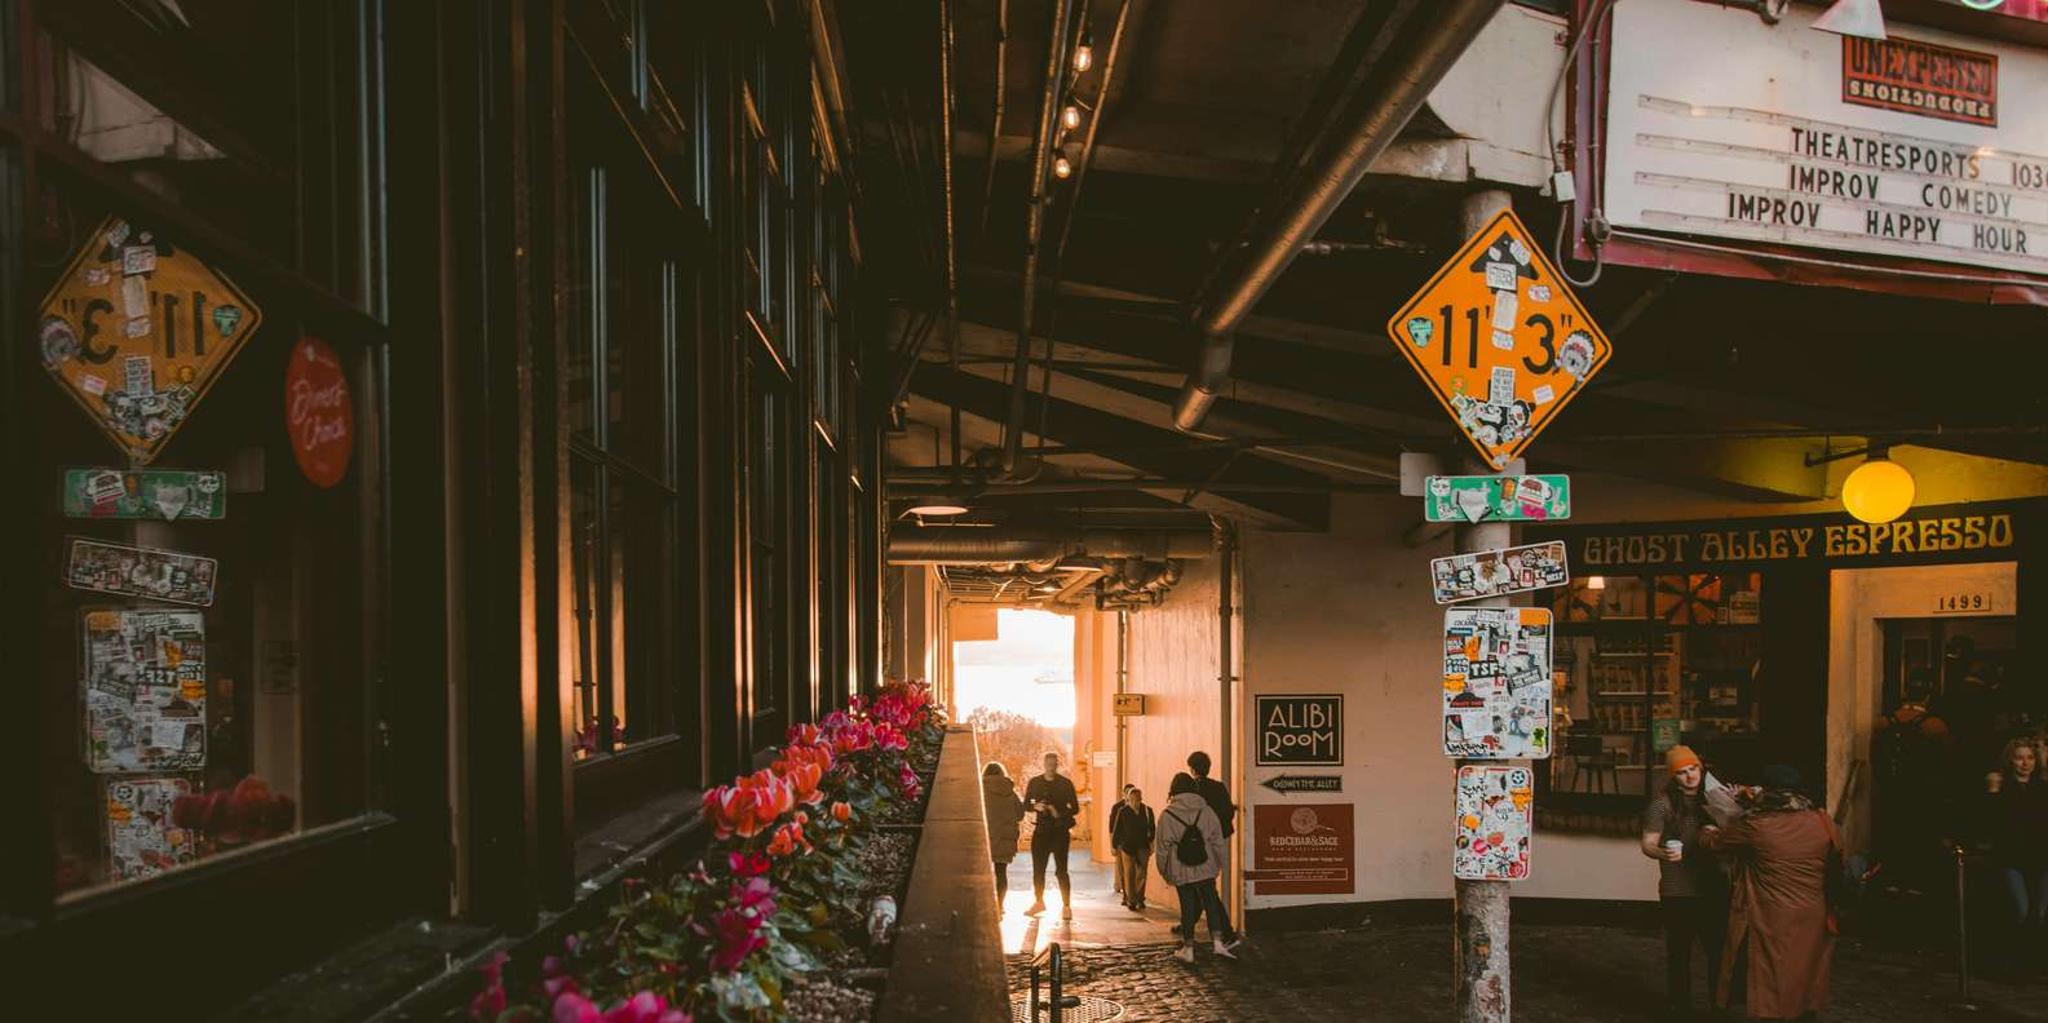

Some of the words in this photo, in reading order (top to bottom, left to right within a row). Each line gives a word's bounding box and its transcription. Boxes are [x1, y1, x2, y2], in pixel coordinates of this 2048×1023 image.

[1850, 80, 1990, 117] PRODUCTIONS
[1791, 127, 1980, 180] THEATRESPORTS
[2012, 162, 2048, 189] 103
[1790, 164, 1879, 200] IMPROV
[1922, 183, 2012, 217] COMEDY
[1729, 193, 1820, 228] IMPROV
[1866, 209, 1941, 242] HAPPY
[1974, 222, 2027, 254] HOUR
[1584, 534, 1690, 565] GHOST
[1701, 528, 1814, 562] ALLEY
[1824, 515, 2014, 557] ESPRESSO
[1939, 595, 1983, 610] 1499
[1268, 703, 1333, 728] ALIBI
